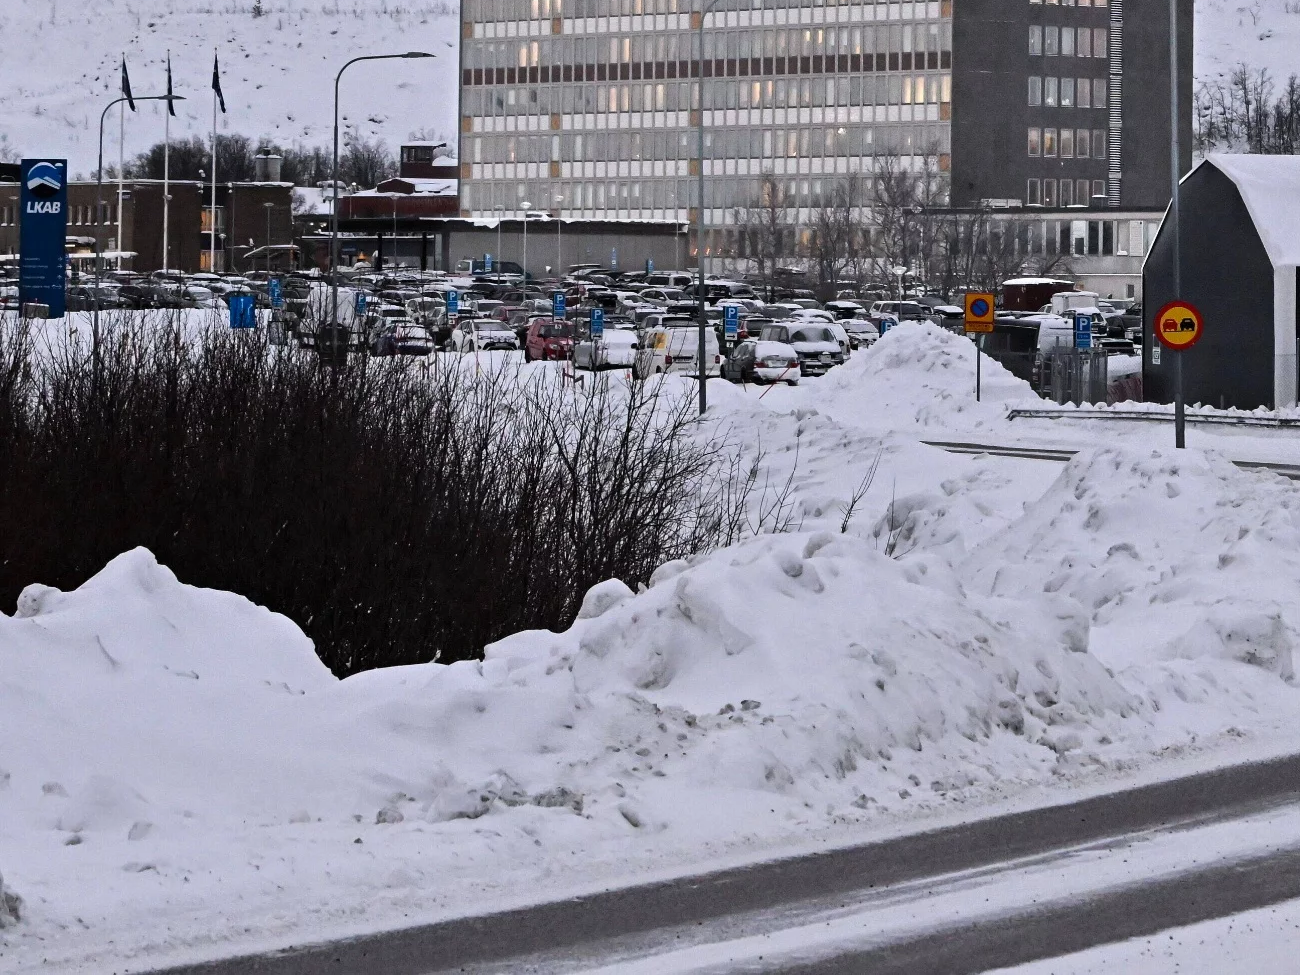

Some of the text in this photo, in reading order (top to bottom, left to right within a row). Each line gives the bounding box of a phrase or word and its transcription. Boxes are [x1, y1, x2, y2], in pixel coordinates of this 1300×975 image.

[26, 201, 61, 214] LKAB
[450, 291, 456, 301] P
[556, 295, 564, 304] P
[594, 309, 602, 320] P
[728, 307, 736, 319] P
[1079, 317, 1089, 331] P
